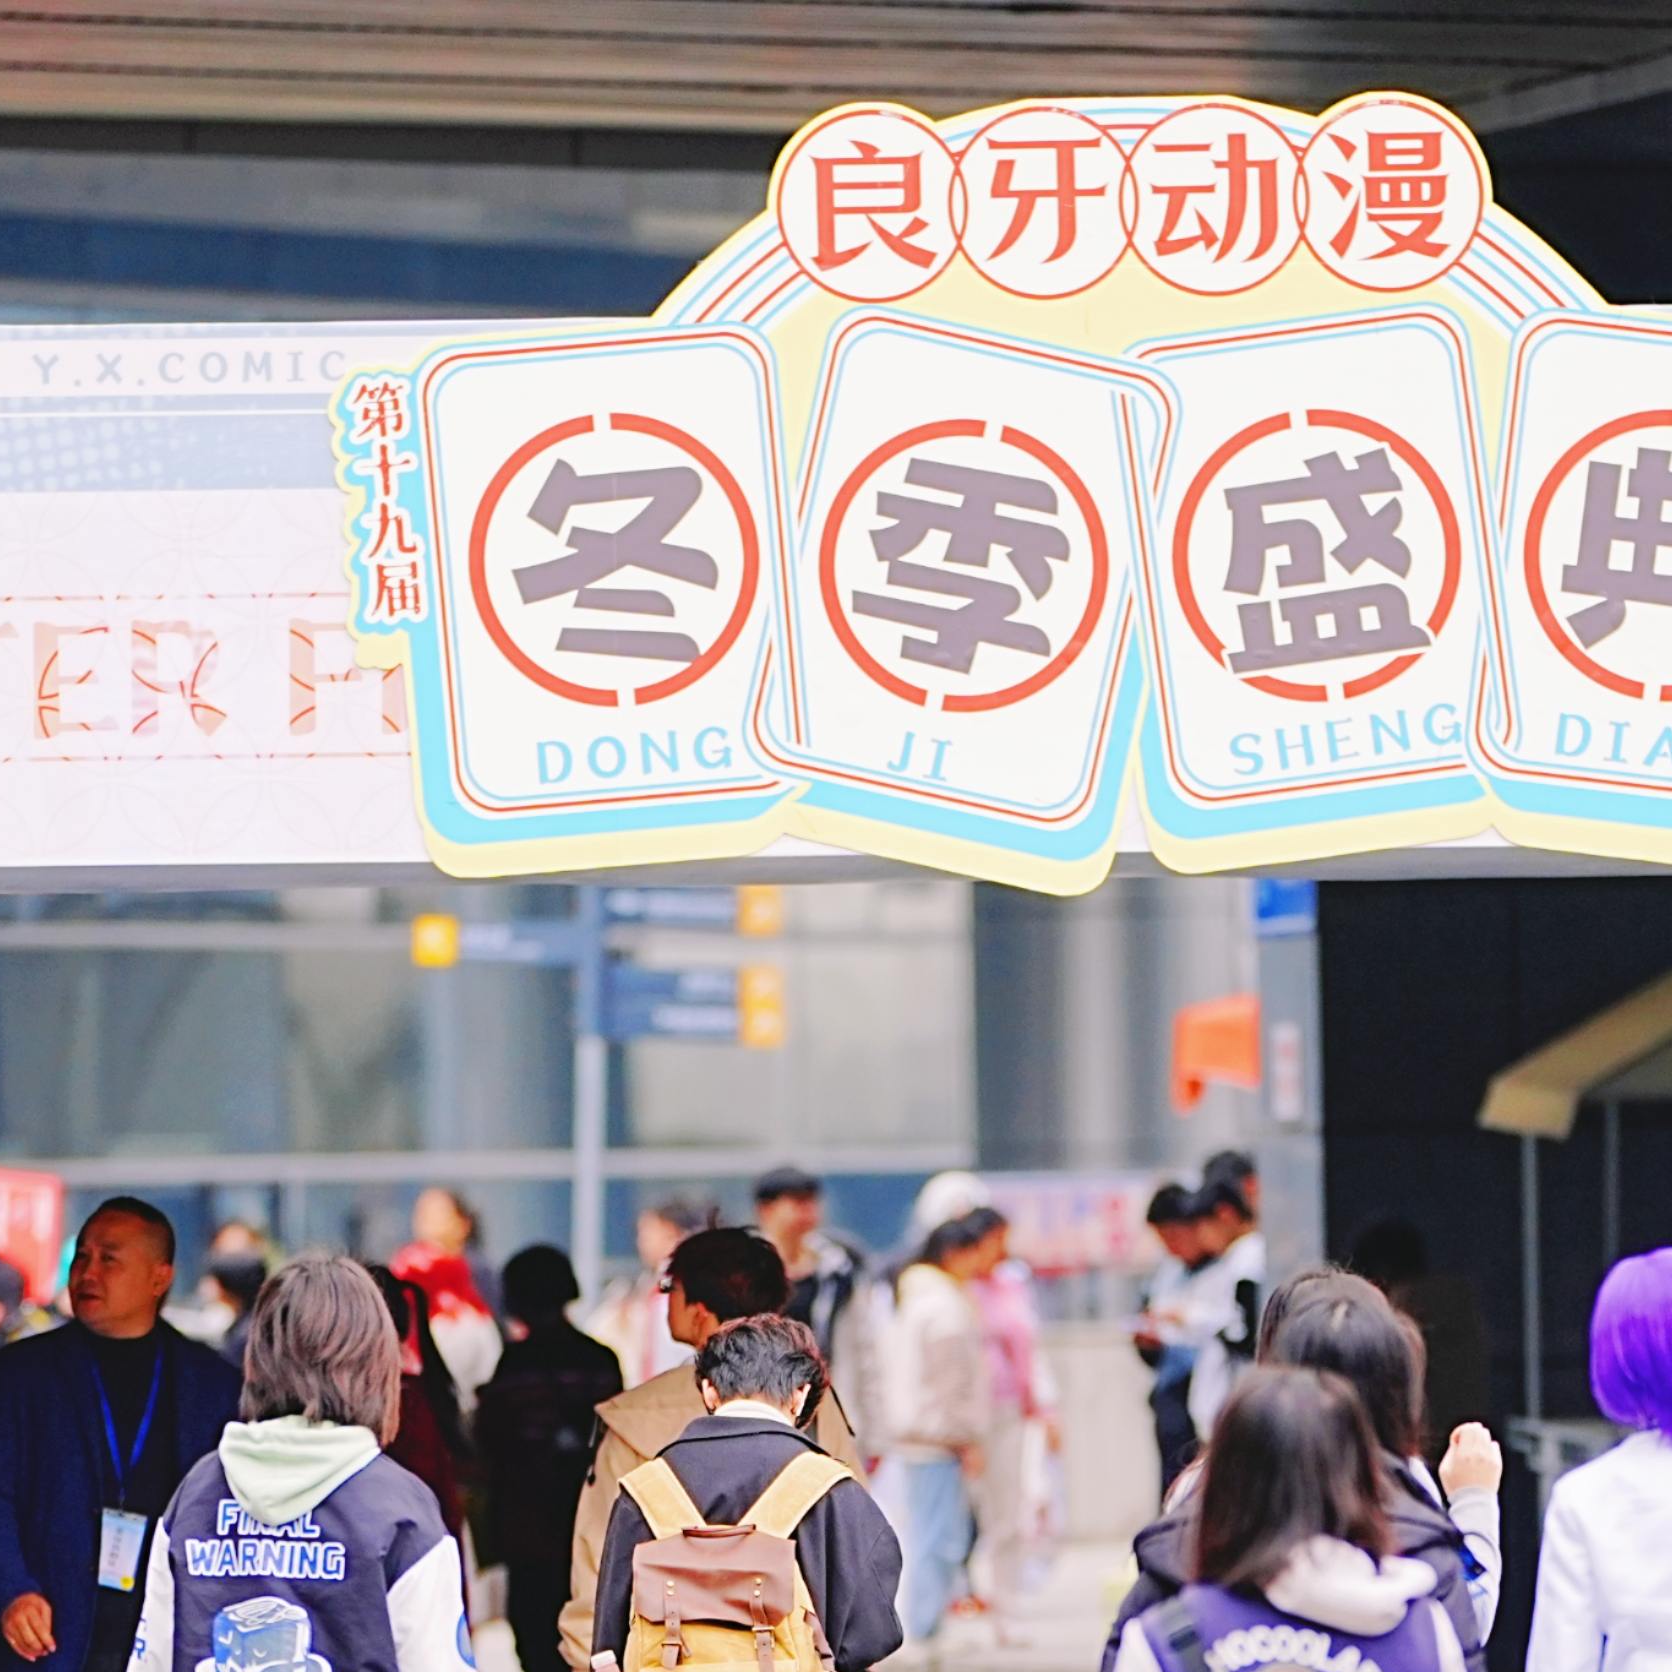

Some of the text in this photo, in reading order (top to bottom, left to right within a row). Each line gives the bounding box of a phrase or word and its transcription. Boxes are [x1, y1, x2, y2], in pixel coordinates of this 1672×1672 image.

[808, 130, 1451, 272] 良牙动漫
[31, 350, 346, 389] Y.X.COMIC
[352, 381, 424, 618] 第十九届
[536, 725, 733, 785] DONG
[887, 731, 953, 783] JI
[1229, 703, 1463, 776] SHENG
[184, 1538, 346, 1581] WARNING
